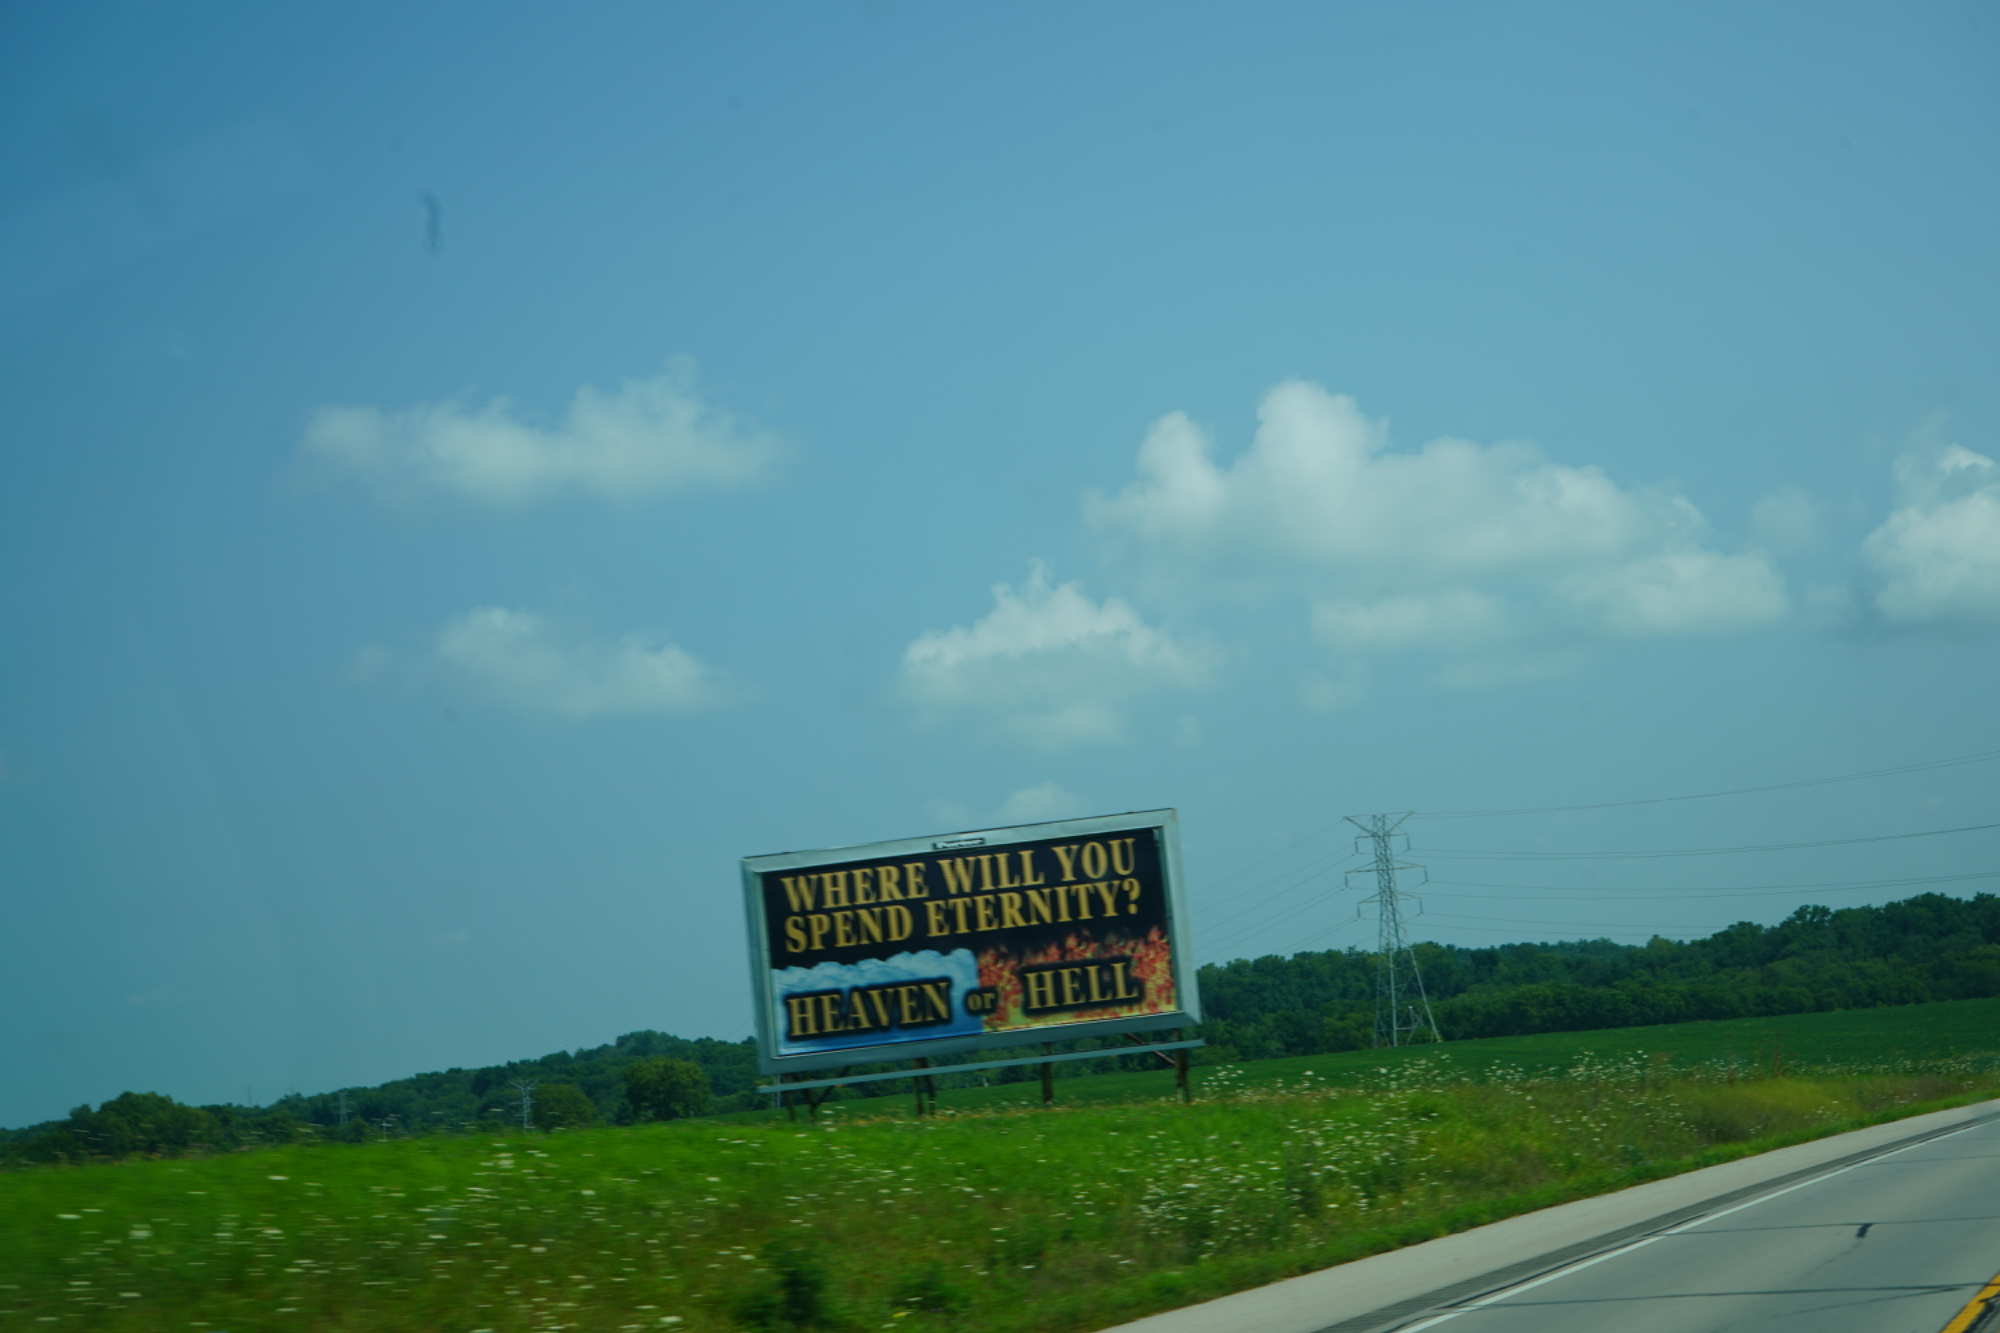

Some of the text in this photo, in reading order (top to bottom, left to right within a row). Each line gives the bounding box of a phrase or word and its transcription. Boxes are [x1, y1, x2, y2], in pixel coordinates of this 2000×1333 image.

[780, 838, 1136, 912] WHERE WILL YOU
[784, 878, 1141, 953] SPEND ETERNITY?
[786, 962, 1139, 1037] HEAVEN or HELL
